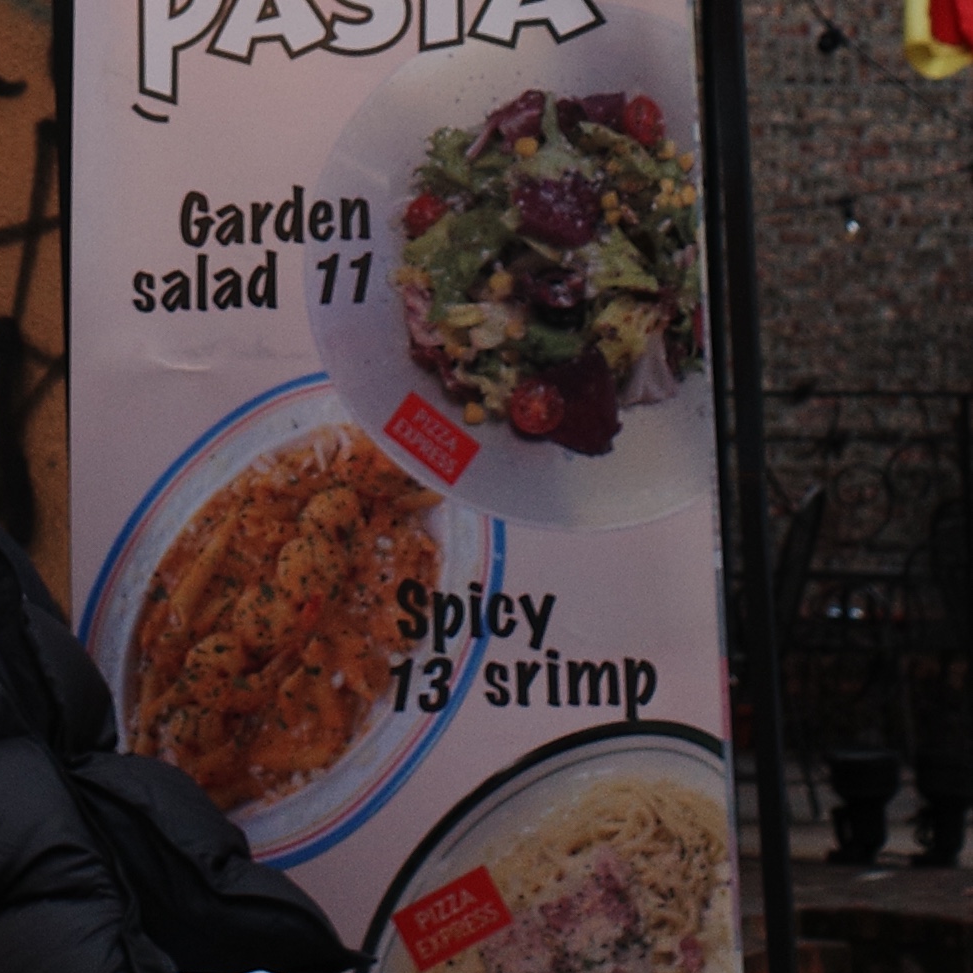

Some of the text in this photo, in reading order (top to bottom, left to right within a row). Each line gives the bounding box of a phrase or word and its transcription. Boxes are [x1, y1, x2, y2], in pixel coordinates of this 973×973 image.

[180, 185, 372, 247] Garden
[132, 251, 373, 313] salad 11
[412, 407, 458, 453] PIZZA
[396, 578, 556, 654] Spicy
[389, 649, 658, 722] 13 srimp
[413, 888, 478, 932] PIZZA
[415, 901, 501, 960] EXPRESS
